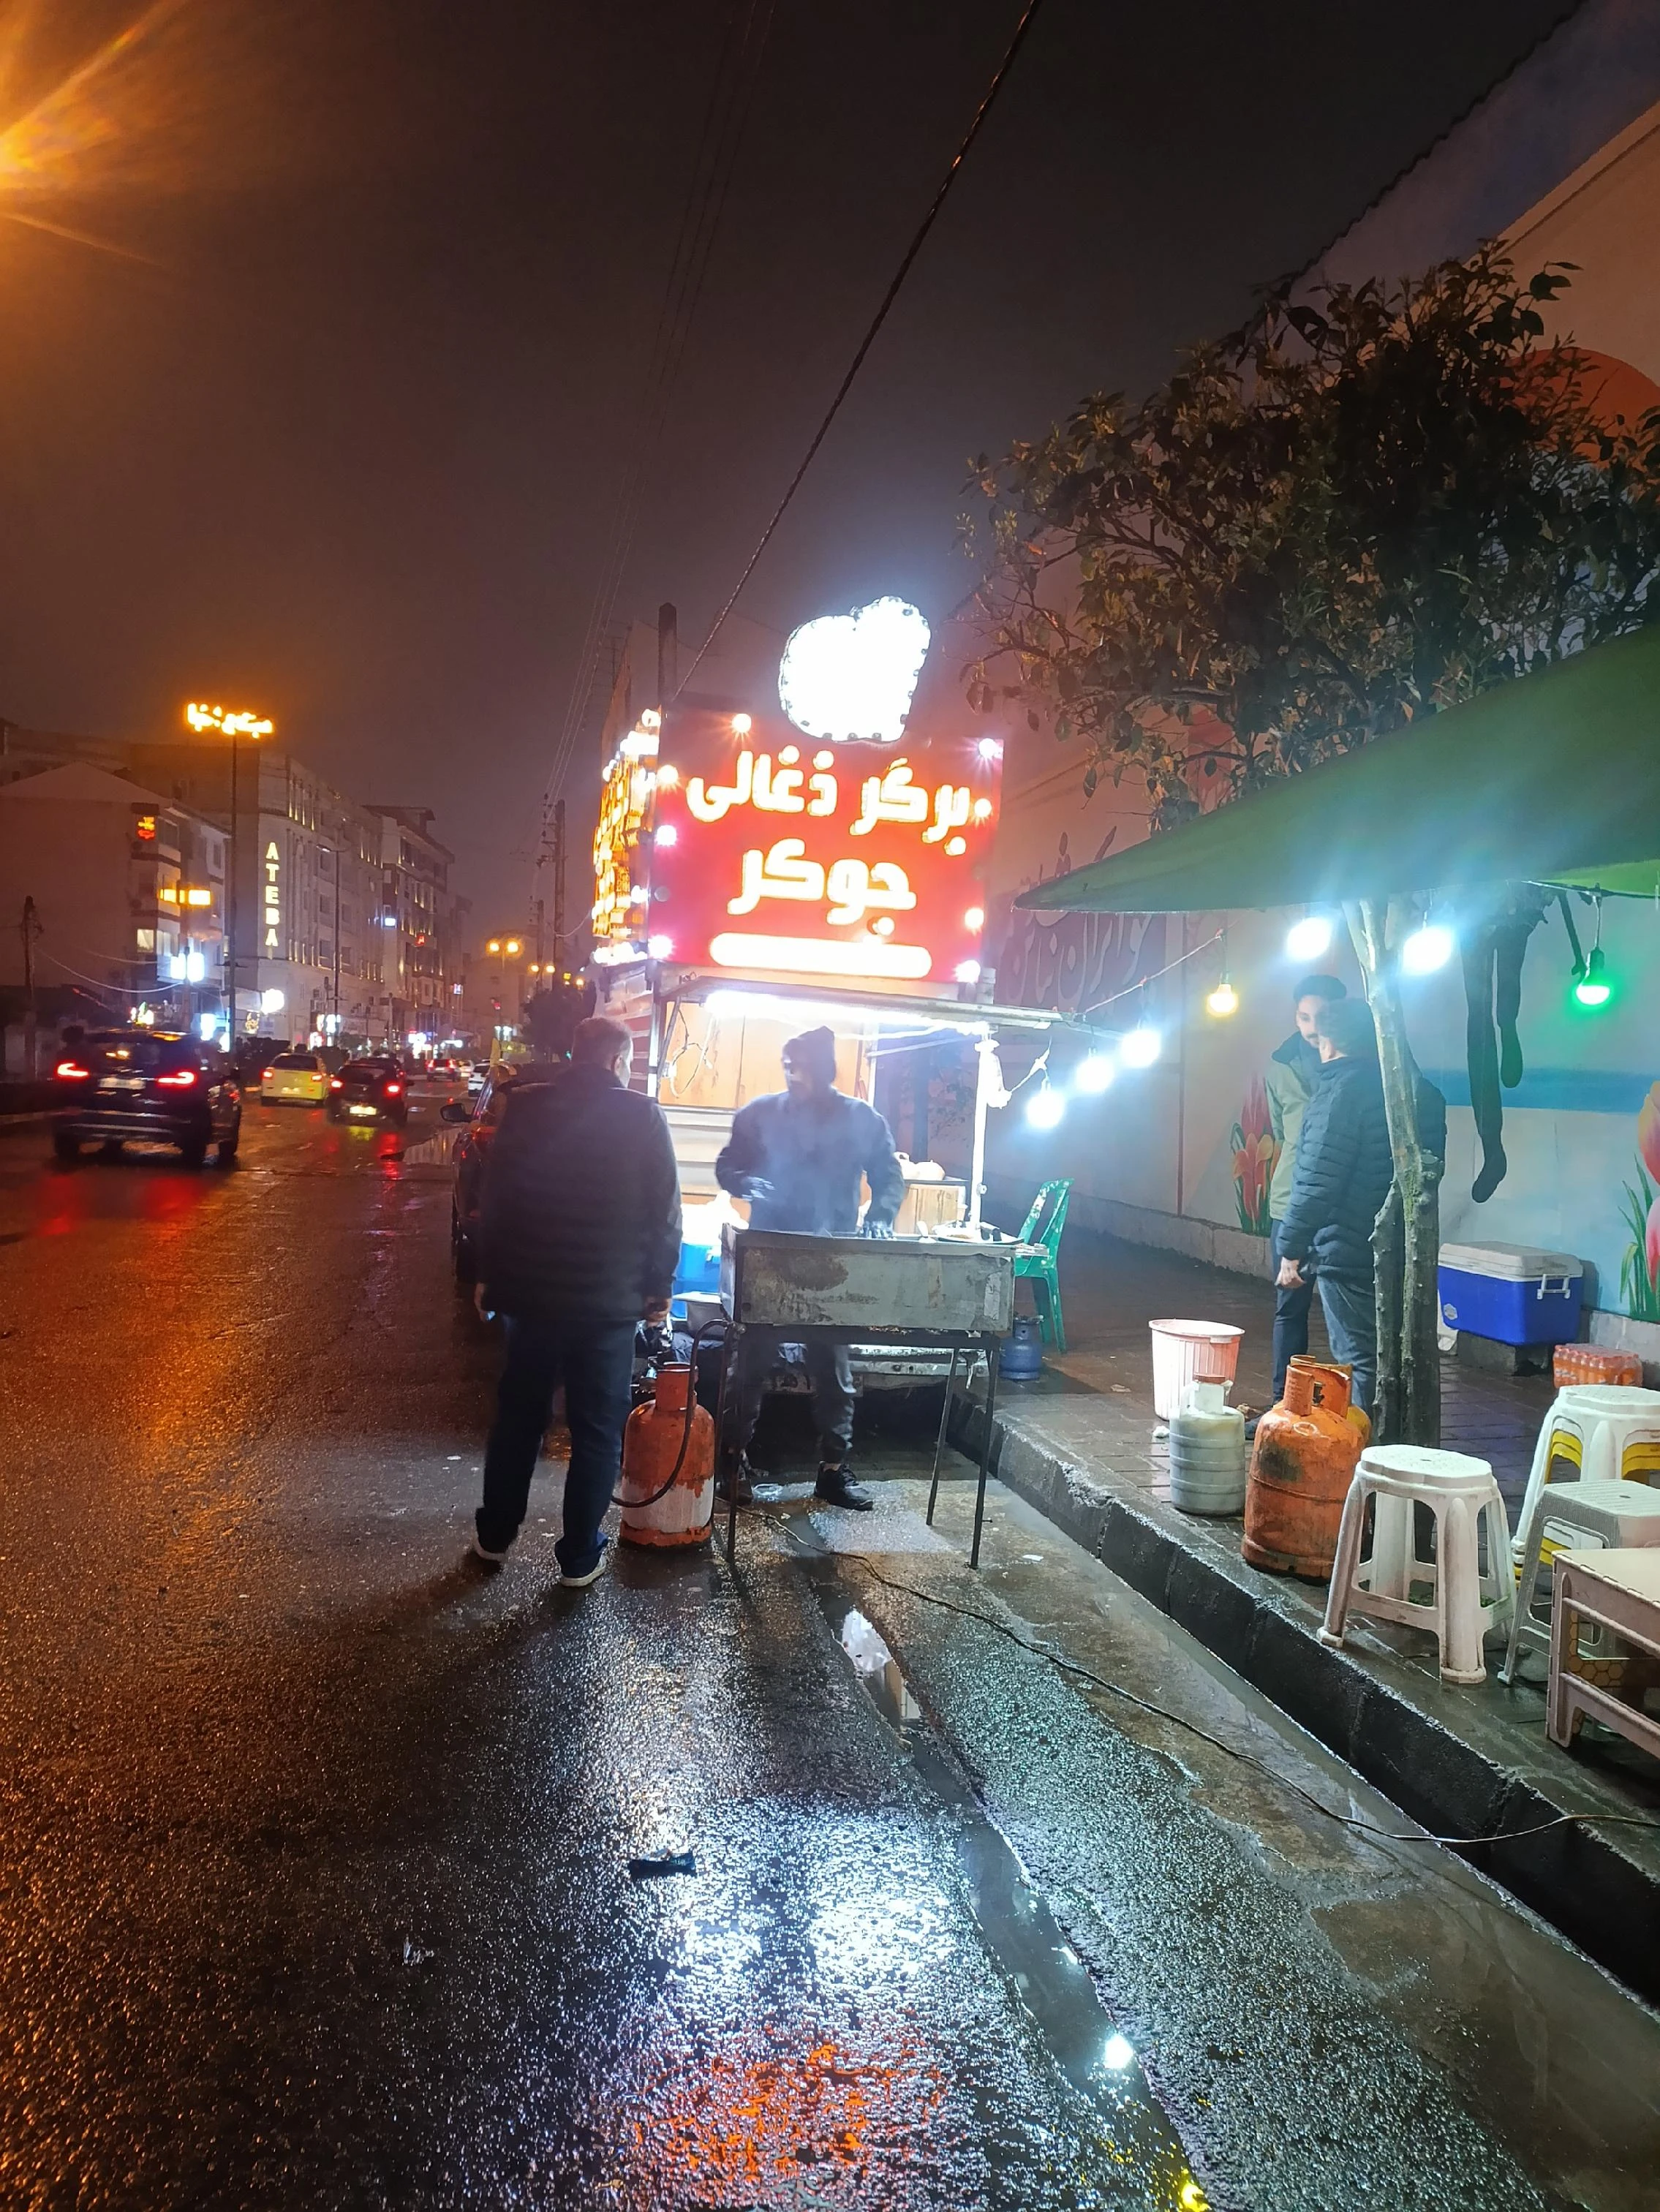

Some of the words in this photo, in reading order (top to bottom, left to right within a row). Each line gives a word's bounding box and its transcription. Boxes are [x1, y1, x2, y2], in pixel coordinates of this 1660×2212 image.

[685, 744, 837, 823] ذغالی
[848, 758, 971, 856] برگر
[265, 842, 280, 946] ATEBA
[727, 838, 917, 934] جوکر
